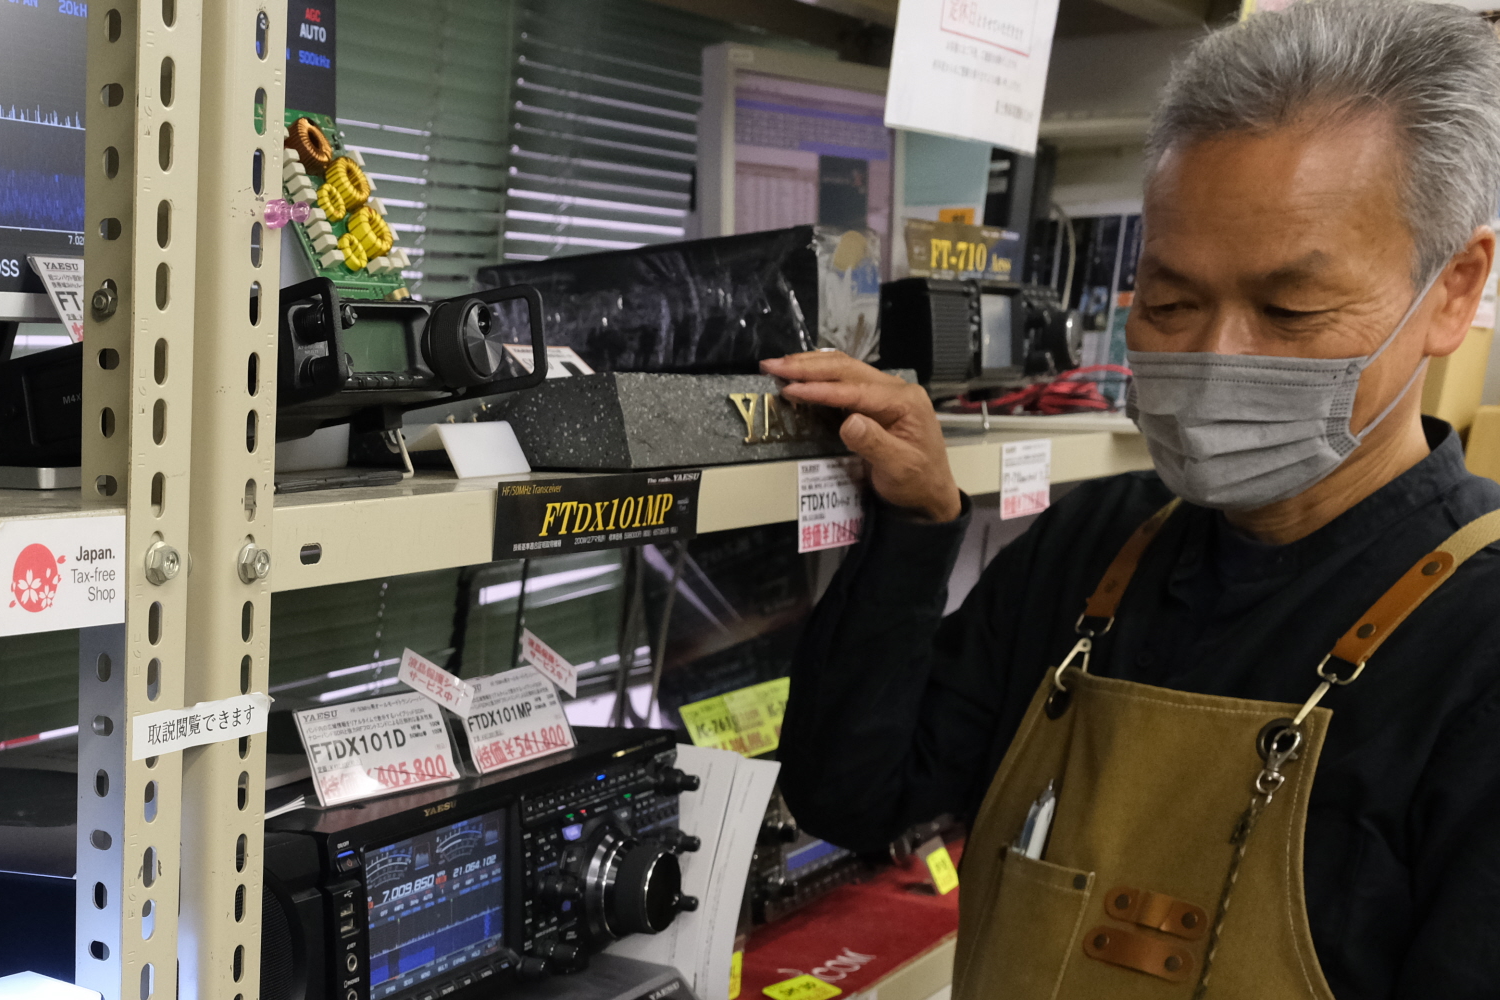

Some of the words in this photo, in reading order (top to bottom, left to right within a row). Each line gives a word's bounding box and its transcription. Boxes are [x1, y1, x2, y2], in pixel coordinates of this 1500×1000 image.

[305, 8, 320, 22] AGC
[300, 23, 326, 43] AUTO
[298, 50, 330, 69] 500kHz
[930, 239, 987, 271] FT-710
[43, 262, 78, 271] YAESU
[673, 472, 700, 483] YAESU
[502, 485, 531, 496] HF/50MHz
[532, 484, 562, 495] Transceiver
[539, 493, 673, 537] FTDX101MP
[76, 545, 116, 564] Japan.
[71, 567, 116, 584] Tax-free
[87, 586, 116, 603] Shop
[147, 704, 255, 746] 取説閲覧できます
[303, 710, 338, 723] YAESU
[467, 701, 532, 733] FTDX101MP
[310, 728, 406, 763] FTDX101D
[423, 800, 457, 817] YAESU
[383, 874, 435, 903] 7.009.850
